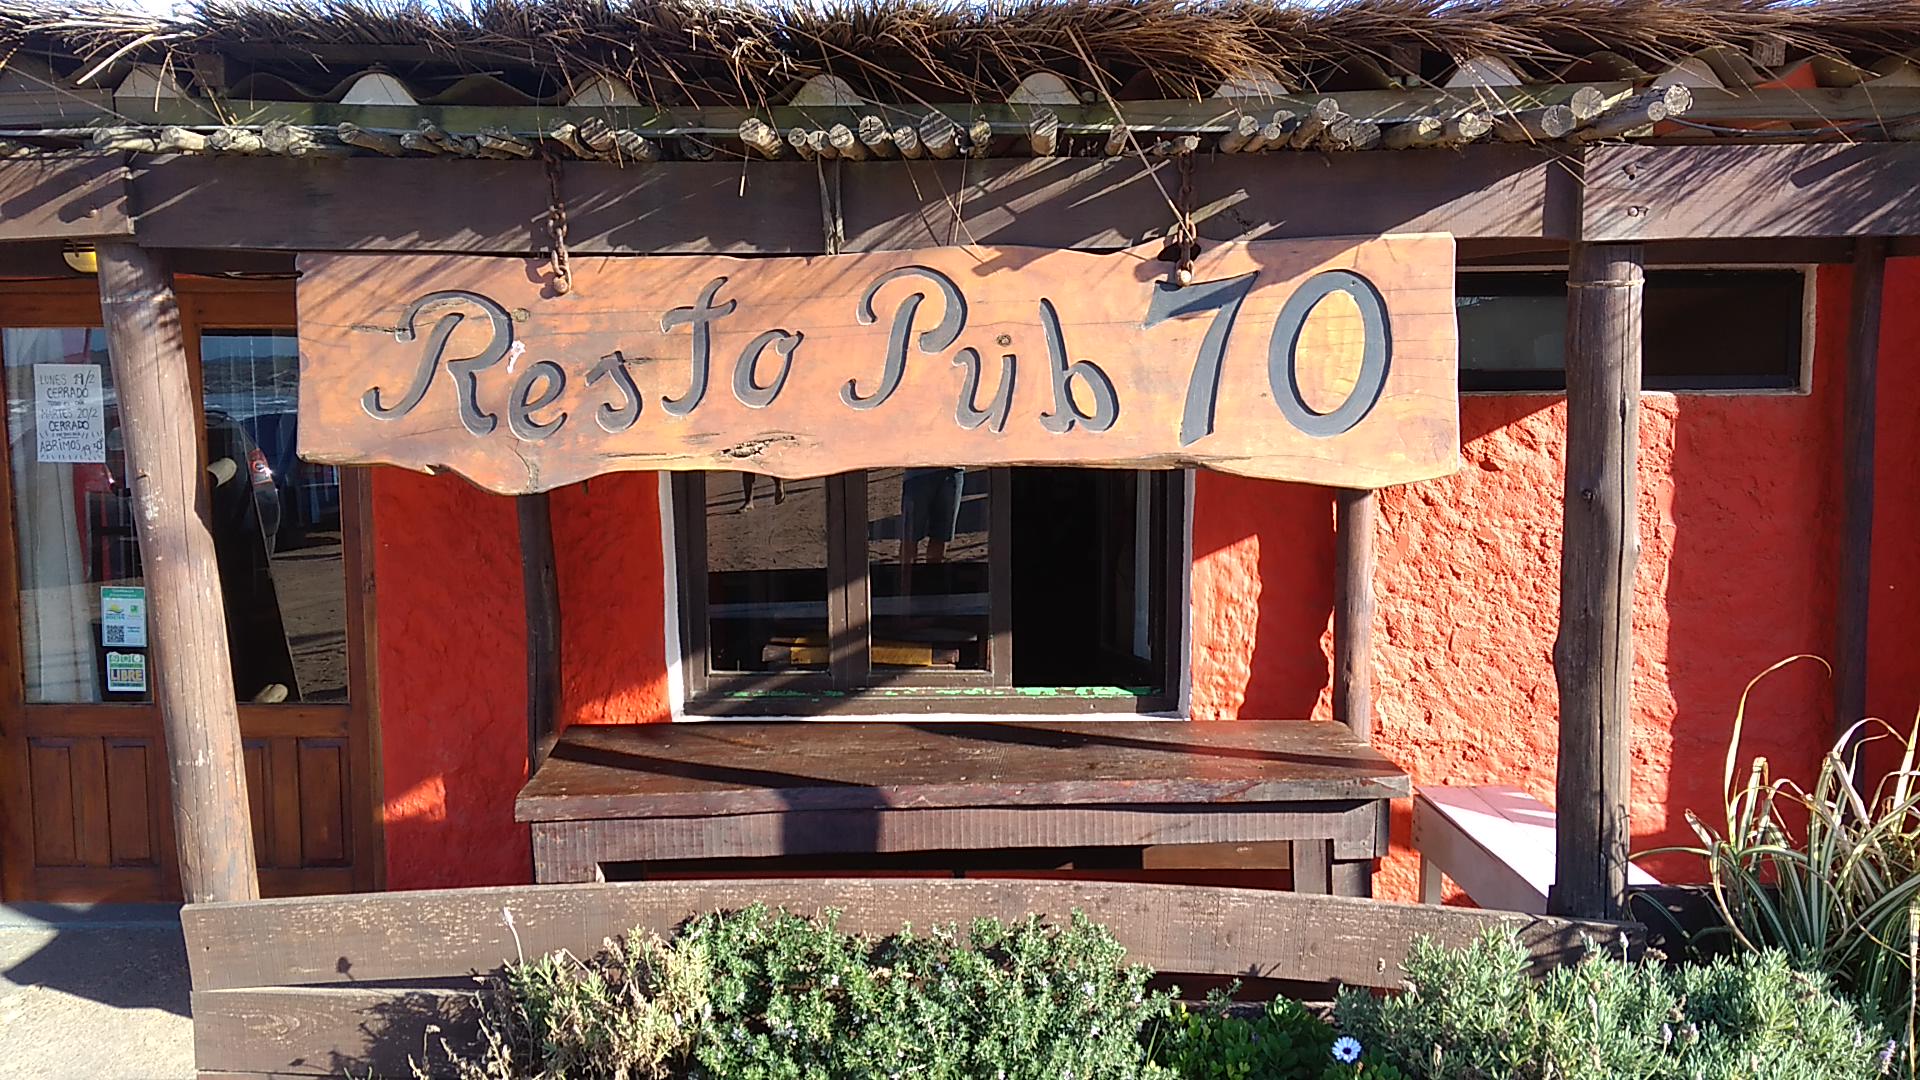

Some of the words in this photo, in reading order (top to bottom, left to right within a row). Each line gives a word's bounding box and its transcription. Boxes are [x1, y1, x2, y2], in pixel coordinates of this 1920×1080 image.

[361, 276, 804, 442] Resto
[839, 265, 1119, 434] Pub
[1142, 269, 1392, 447] 70
[40, 374, 67, 385] LUNES
[47, 387, 88, 398] CERRADO
[77, 407, 98, 420] 20/2
[49, 420, 90, 431] CERRADO
[110, 669, 144, 682] LIBRE
